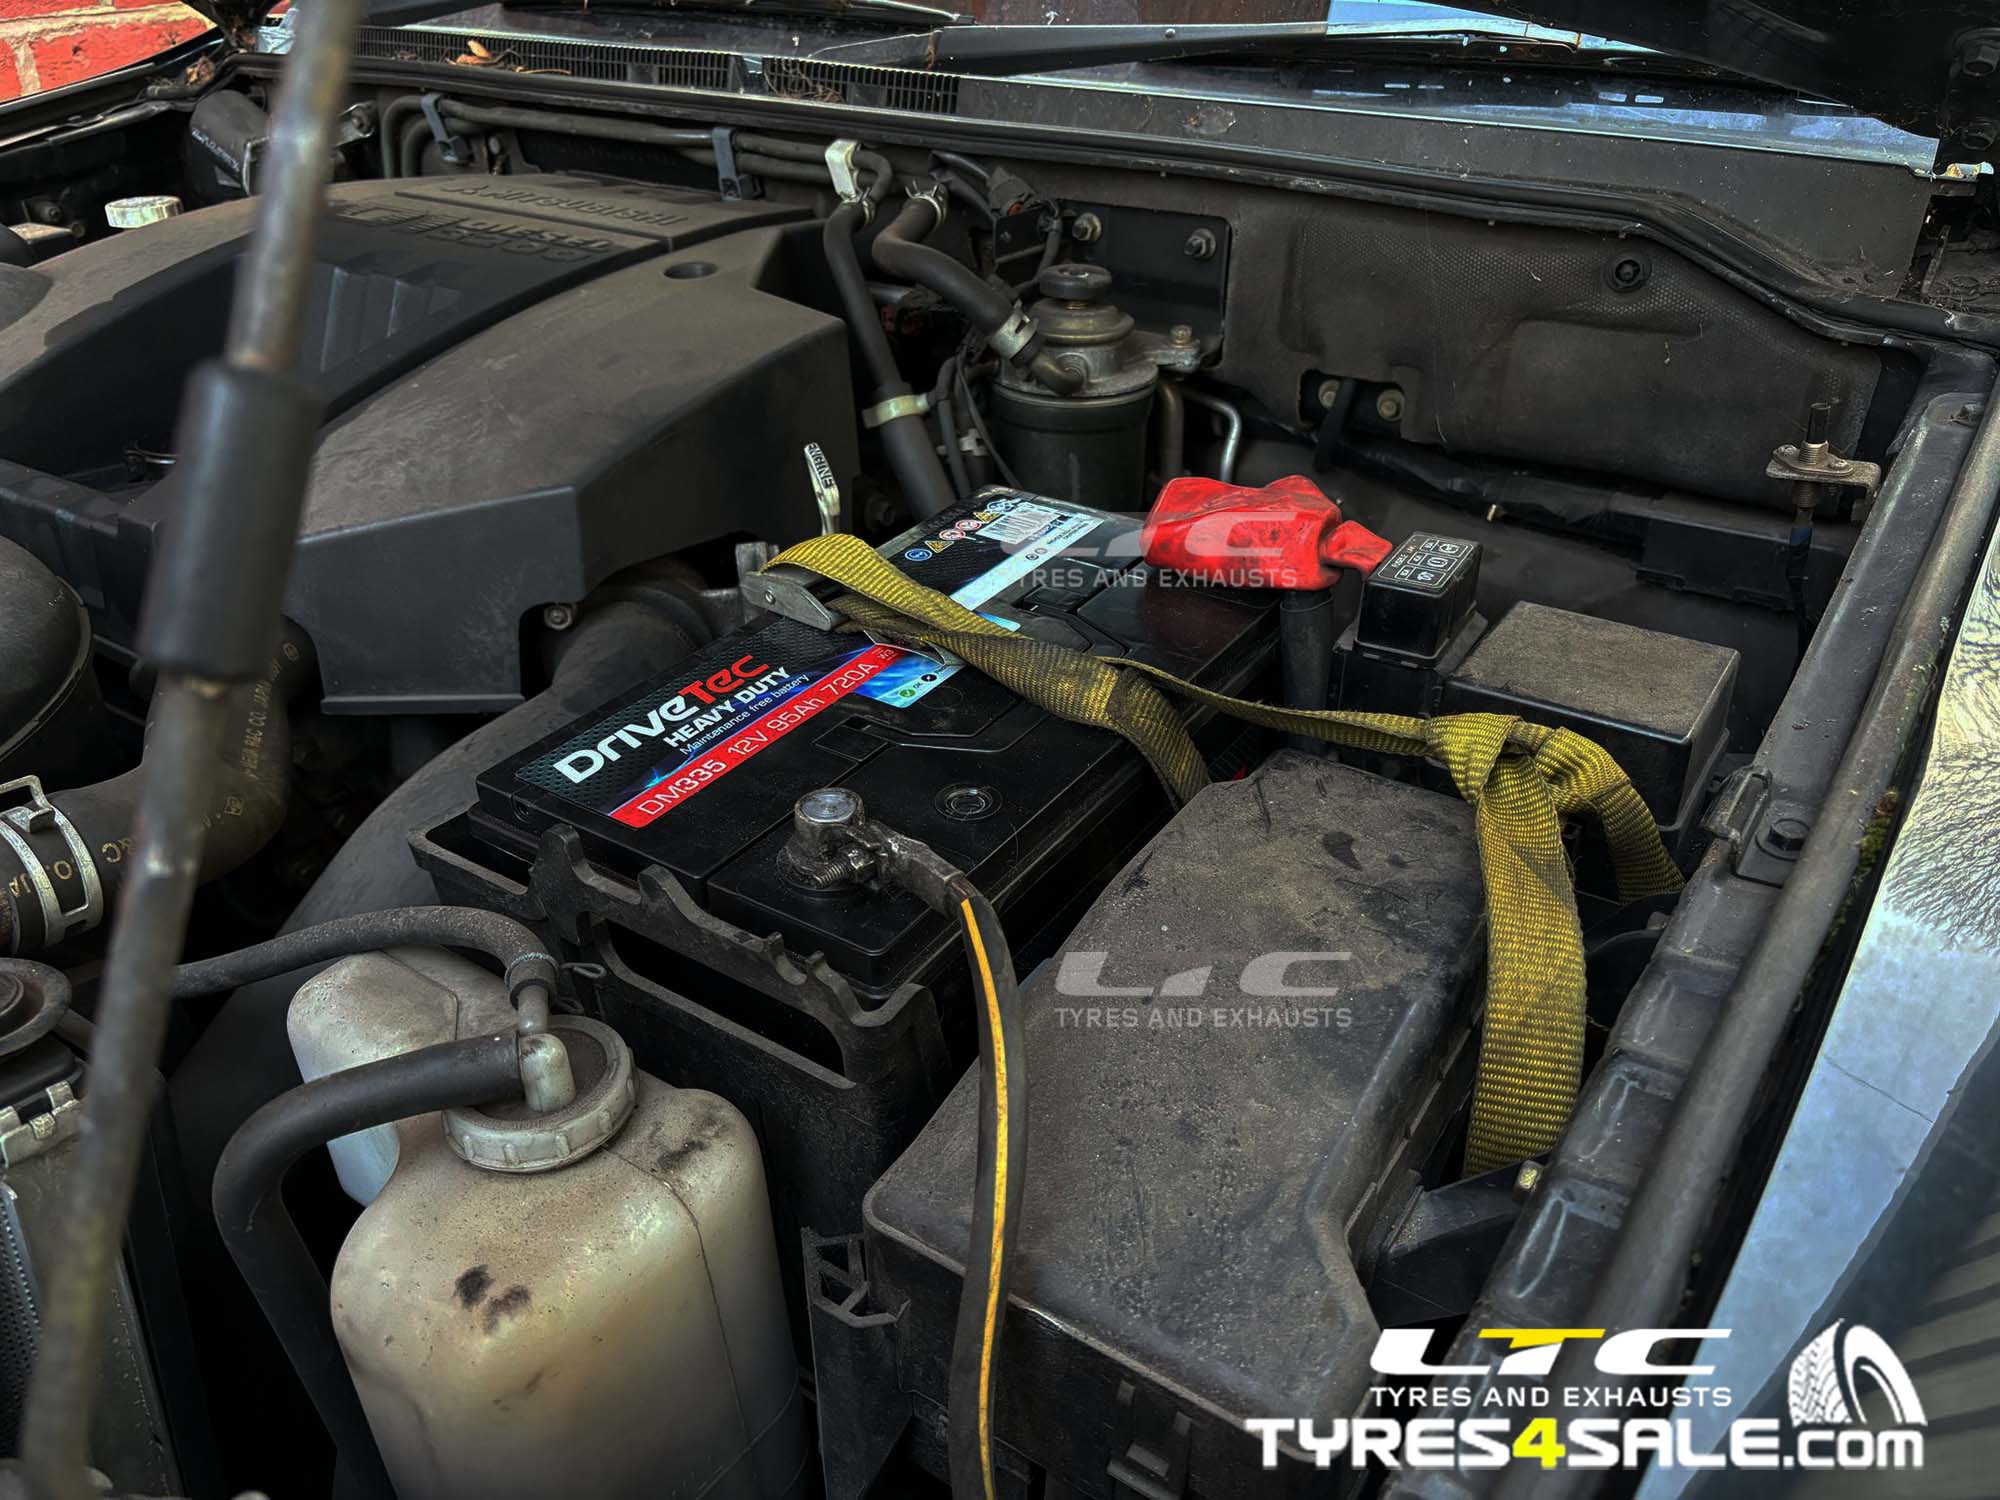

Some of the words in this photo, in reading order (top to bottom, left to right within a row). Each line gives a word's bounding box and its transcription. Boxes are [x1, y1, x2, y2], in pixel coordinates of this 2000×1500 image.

[455, 218, 618, 251] DIESEL
[476, 188, 690, 227] MITSUBISHI
[808, 442, 833, 489] ENGINE
[637, 758, 728, 816] DM335
[728, 730, 769, 756] 12V
[766, 697, 826, 732] 95Ah
[820, 661, 881, 697] 720A
[663, 700, 735, 748] HEAVY
[734, 666, 791, 704] DUTY
[680, 711, 751, 755] Maintenance
[749, 697, 773, 713] free
[770, 674, 810, 698] battery
